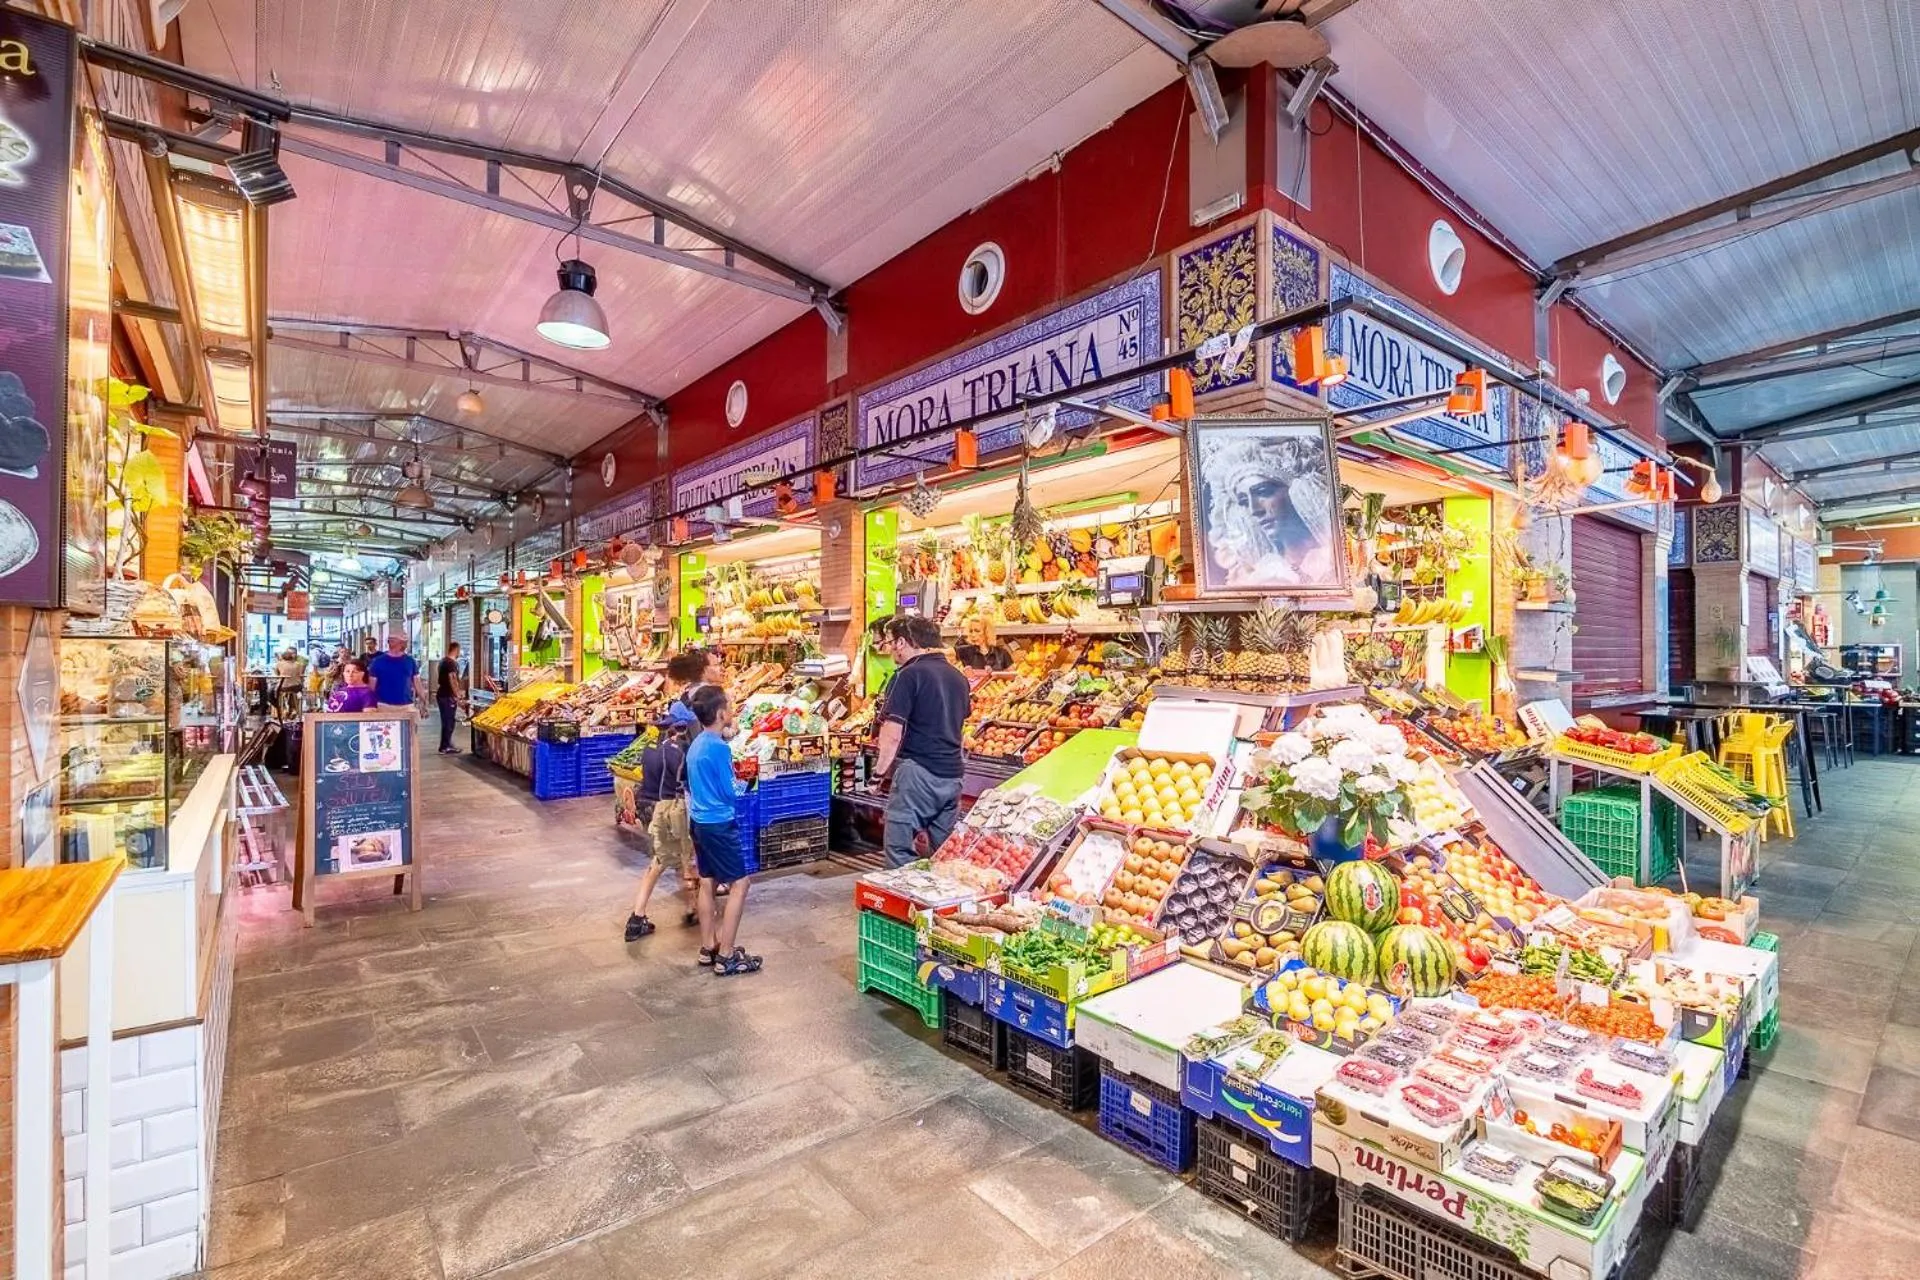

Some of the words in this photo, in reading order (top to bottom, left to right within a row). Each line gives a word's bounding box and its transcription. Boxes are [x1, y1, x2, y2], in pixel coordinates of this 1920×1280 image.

[1117, 336, 1139, 360] 45
[1347, 316, 1414, 398] MORA
[873, 387, 951, 451] MORA
[962, 331, 1103, 421] TRIANA
[1207, 766, 1231, 812] Perlim
[1004, 968, 1031, 988] SABOR
[1042, 983, 1060, 999] SUR
[1354, 1145, 1469, 1221] Perlim
